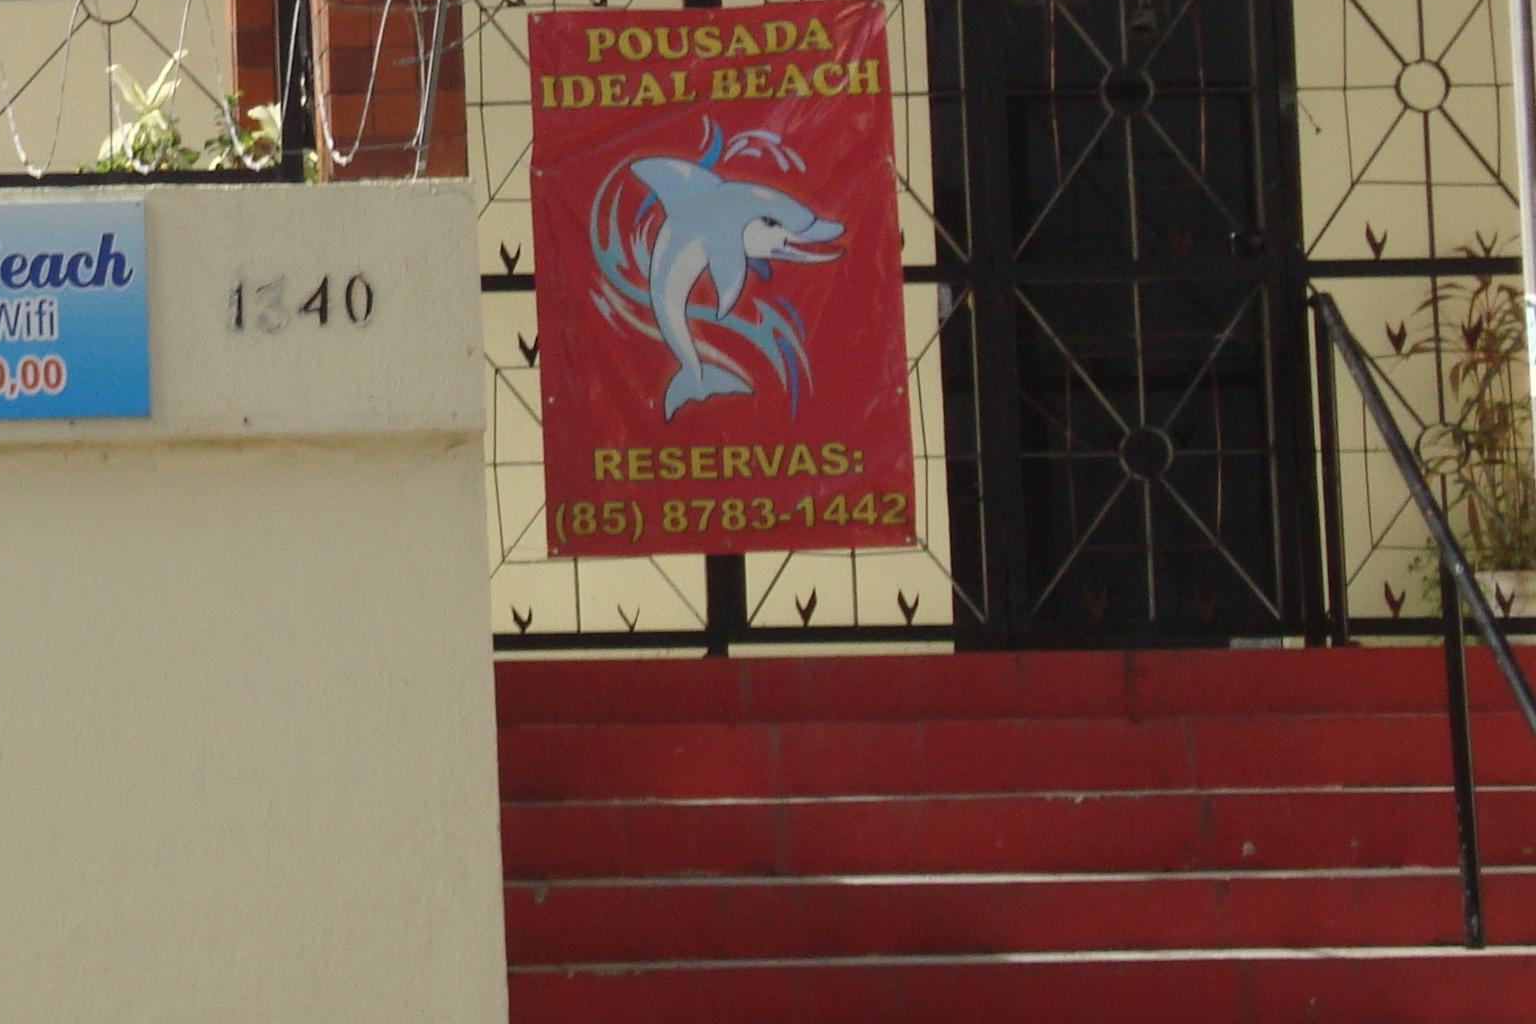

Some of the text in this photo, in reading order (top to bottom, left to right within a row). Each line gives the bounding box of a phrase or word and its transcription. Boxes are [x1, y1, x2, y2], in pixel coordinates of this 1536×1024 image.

[586, 17, 834, 62] POUSADA
[540, 59, 882, 110] IDEAL BEACH
[229, 271, 374, 333] 1340
[594, 442, 865, 481] RESERVAS:
[554, 492, 908, 543] (85) 8783-1442
